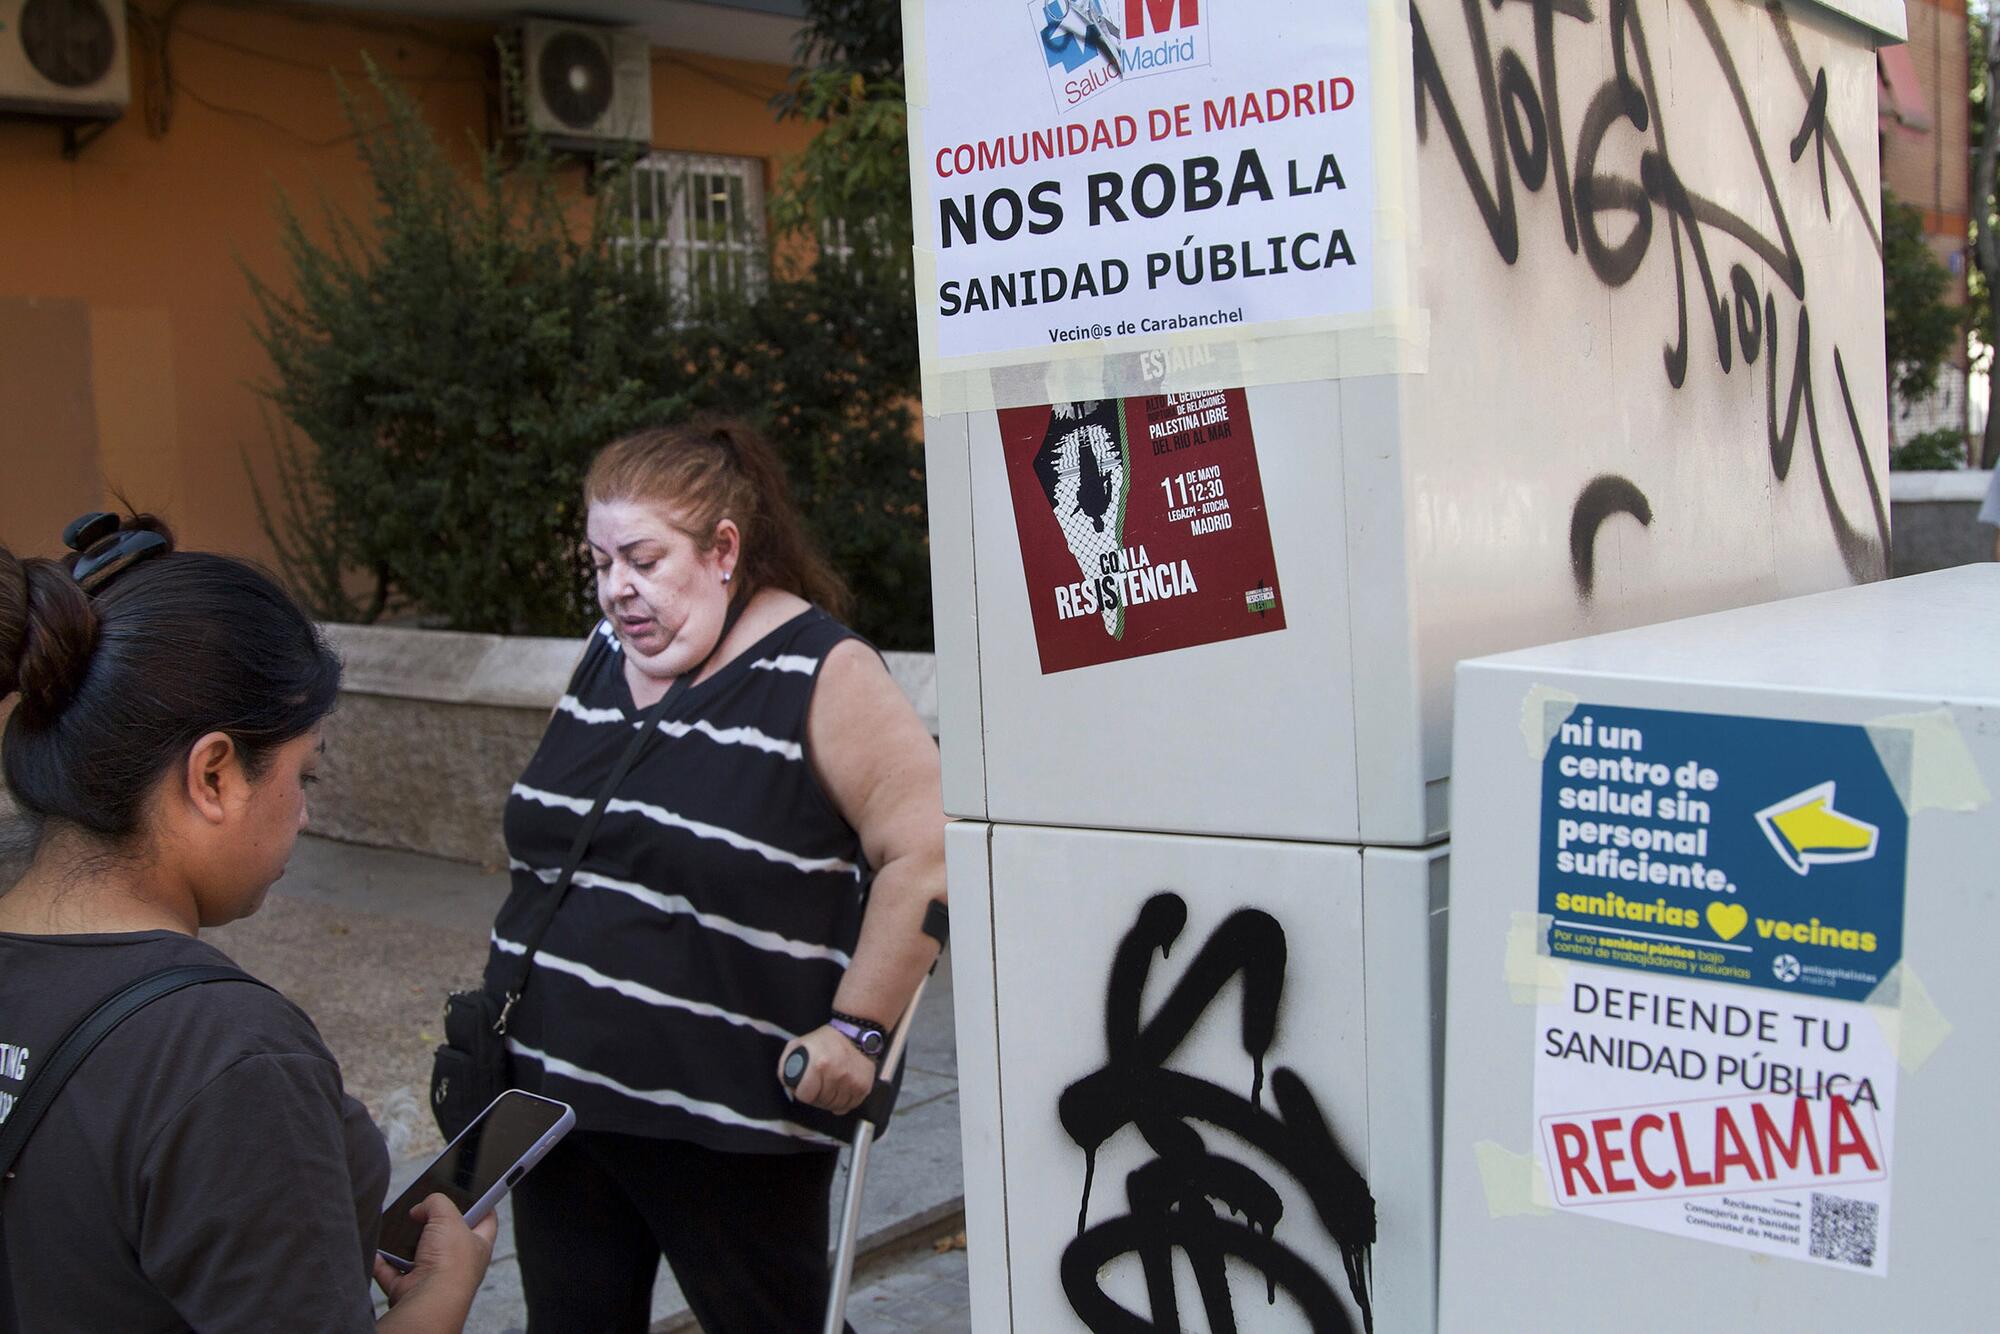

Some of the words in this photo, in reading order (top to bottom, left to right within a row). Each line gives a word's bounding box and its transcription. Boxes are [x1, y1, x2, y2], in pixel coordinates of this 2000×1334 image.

[1121, 35, 1194, 73] Madrid
[936, 114, 1138, 178] COMUNIDAD
[1149, 103, 1193, 142] DE
[1204, 76, 1355, 133] MADRID
[940, 180, 1064, 248] NOS
[1088, 148, 1274, 226] ROBA
[1289, 153, 1347, 197] LA
[940, 258, 1130, 316] SANIDAD
[1147, 228, 1357, 290] PÚBLICA
[1048, 323, 1112, 343] Vecin@s
[1116, 319, 1136, 336] de
[1141, 307, 1244, 333] Carabanchel
[1140, 344, 1217, 381] ESTATAL
[1167, 392, 1179, 406] AL
[1177, 404, 1187, 415] DE
[1187, 394, 1226, 412] RELACIONES
[1149, 413, 1200, 440] PALESTINA
[1200, 405, 1229, 426] LIBRE
[1152, 438, 1172, 456] DEL
[1193, 430, 1206, 447] AL
[1207, 423, 1232, 442] MAR
[1160, 473, 1189, 508] 11
[1186, 470, 1198, 484] DE
[1197, 465, 1220, 481] MAYO
[1189, 478, 1224, 503] 12:30
[1168, 506, 1197, 522] LEGAZPI
[1202, 498, 1229, 515] ATOCHA
[1190, 513, 1232, 536] MADRID
[1099, 548, 1129, 575] CON
[1129, 545, 1150, 569] LA
[1054, 559, 1198, 620] RESISTENCIA
[1560, 715, 1594, 746] ni
[1598, 725, 1643, 751] un
[1559, 755, 1670, 786] centro
[1674, 760, 1719, 791] de
[1558, 785, 1653, 818] salud
[1657, 790, 1710, 824] sin
[1557, 818, 1708, 857] personal
[1556, 848, 1737, 894] suficiente.
[1555, 891, 1699, 929] sanitarias
[1755, 917, 1877, 952] vecinas
[1554, 929, 1573, 942] Por
[1574, 933, 1597, 944] una
[1599, 937, 1648, 953] sanidad
[1697, 949, 1726, 964] bajo
[1554, 941, 1593, 956] control
[1595, 947, 1610, 959] de
[1611, 950, 1687, 969] trabajadoras
[1689, 961, 1698, 974] y
[1699, 963, 1751, 979] usuarias
[1573, 982, 1778, 1043] DEFIENDE
[1793, 1014, 1850, 1052] TU
[1545, 1027, 1707, 1081] SANIDAD
[1717, 1051, 1881, 1110] PÚBLICA
[1551, 1094, 1880, 1197] RECLAMA
[1722, 1197, 1801, 1220] Reclamaciones
[1741, 1214, 1755, 1223] de
[1758, 1216, 1801, 1233] Sanidad
[1686, 1214, 1745, 1235] Comunidad
[1746, 1227, 1759, 1237] de
[1763, 1231, 1801, 1246] Madrid
